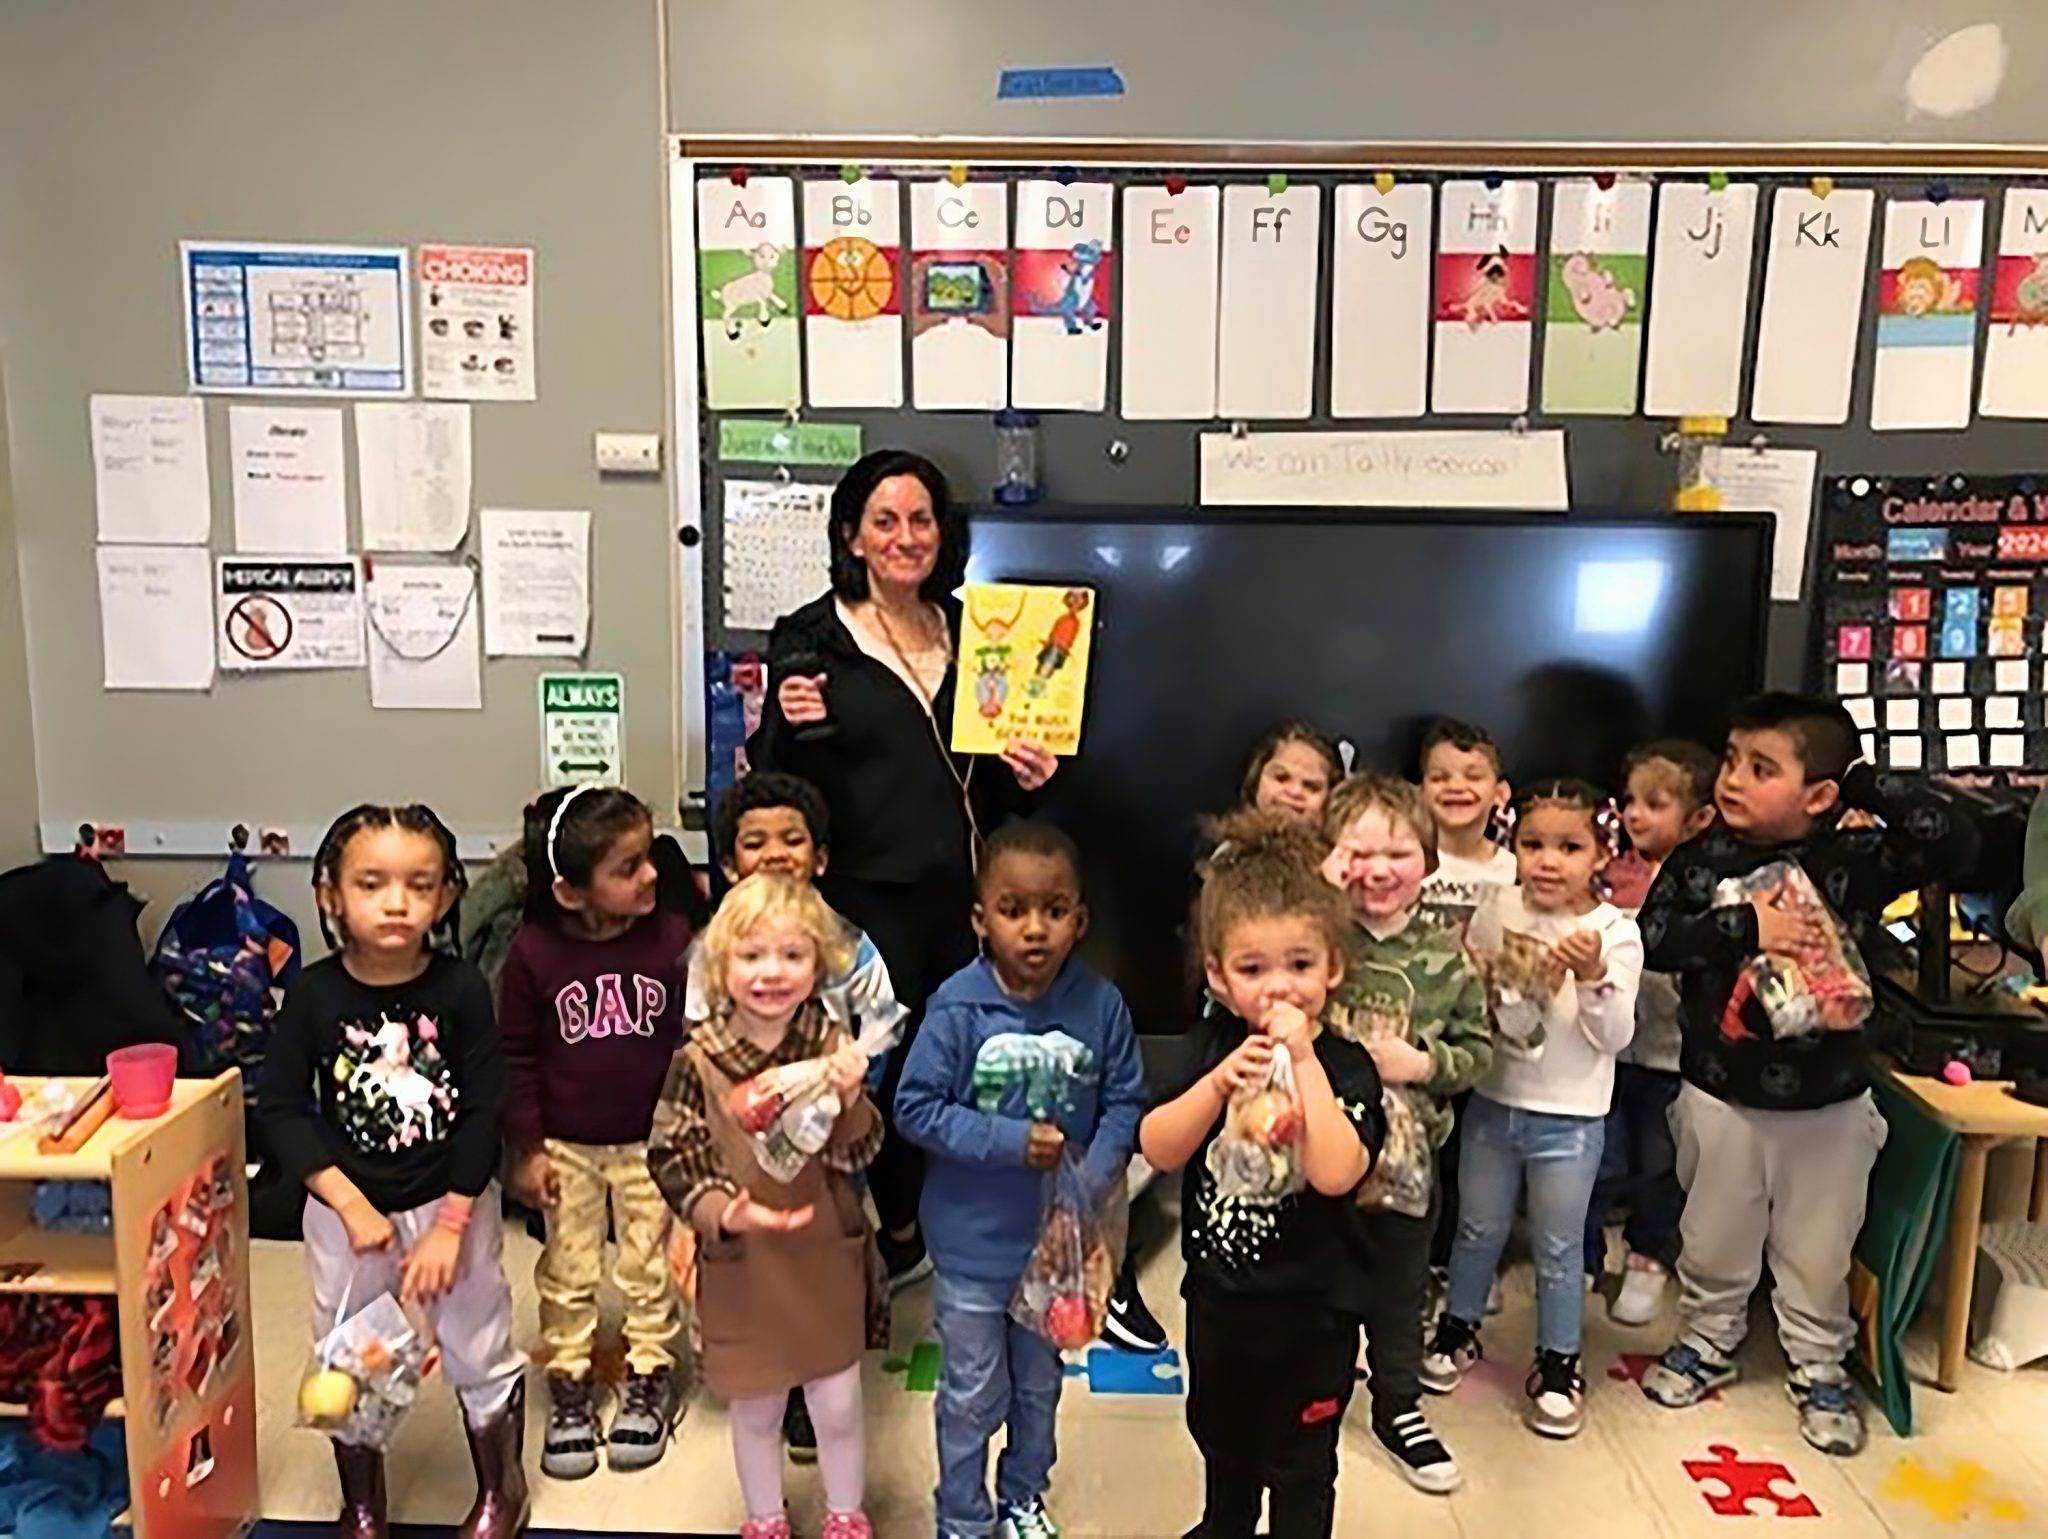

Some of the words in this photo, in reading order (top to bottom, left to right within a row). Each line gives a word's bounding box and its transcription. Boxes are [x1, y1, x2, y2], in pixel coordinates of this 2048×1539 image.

[832, 195, 873, 227] Bb
[936, 197, 980, 229] Cc
[1045, 196, 1085, 228] Dd
[1251, 207, 1292, 243] Ff
[2024, 205, 2048, 233] M
[1356, 206, 1408, 260] Gg
[1687, 206, 1723, 260] Jj
[1795, 211, 1840, 248] Kk
[1920, 217, 1951, 248] Ll
[424, 259, 526, 284] CHOKING
[1226, 450, 1267, 472] We
[1332, 442, 1411, 482] Tally
[1883, 497, 2004, 523] Calendar
[547, 683, 618, 707] ALWAYS
[555, 973, 667, 1044] GAP
